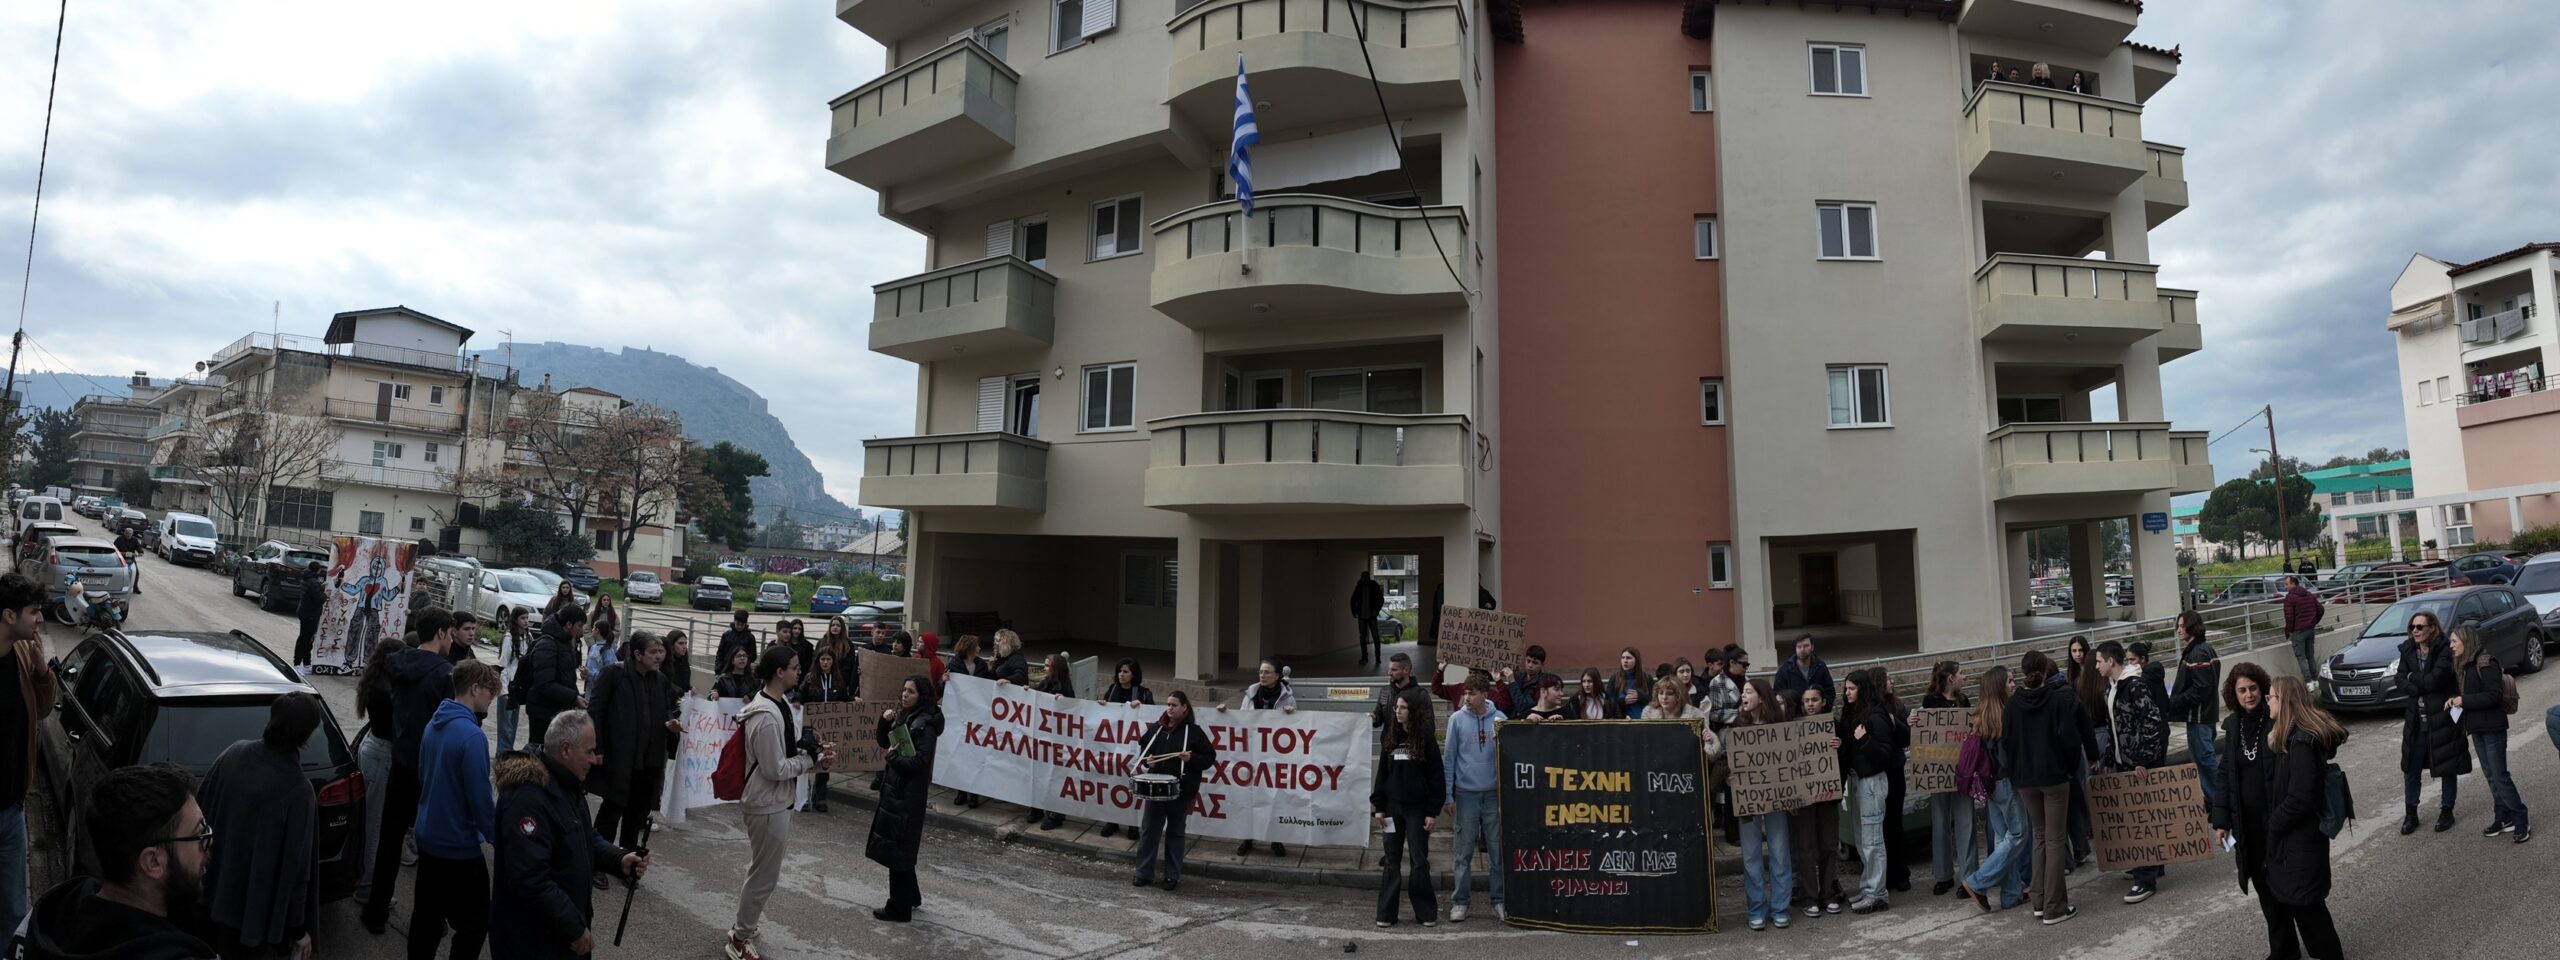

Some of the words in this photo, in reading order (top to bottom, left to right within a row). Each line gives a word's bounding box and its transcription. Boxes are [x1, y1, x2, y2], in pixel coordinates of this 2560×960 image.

[1443, 607, 1463, 618] ΚΑΘΕ
[1468, 610, 1499, 622] ΧΡΟΝΟ
[1501, 615, 1526, 627] ΛΕΝΕ
[1443, 618, 1455, 629] ΘΑ
[1499, 628, 1505, 636] Η
[1441, 630, 1459, 641] ΔΕΙΑ
[1462, 633, 1480, 645] ΕΓΩ
[1482, 637, 1511, 651] ΟΜΩΣ
[1440, 642, 1463, 654] ΚΑΘΕ
[1466, 645, 1495, 659] ΧΡΟΝΟ
[1499, 653, 1522, 664] ΚΑΤΕ
[1475, 658, 1487, 668] ΣΕ
[806, 703, 838, 715] ΕΣΕΙΣ
[846, 701, 866, 713] ΠΟΥ
[810, 716, 852, 730] ΚΟΙΤΑΤΕ
[860, 715, 875, 725] ΤΟΝ
[991, 697, 1031, 727] ΟΧΙ
[1038, 708, 1084, 739] ΣΤΗ
[1258, 727, 1317, 755] ΤΟΥ
[1916, 710, 1959, 727] ΕΜΕΙΣ
[1733, 728, 1777, 746] ΜΟΡΙΑ
[1920, 730, 1937, 744] ΓΙΑ
[964, 722, 1146, 777] ΚΑΛΛΙΤΕΧΝΙΚ
[1733, 750, 1782, 768] ΕΧΟΥΝ
[1786, 749, 1797, 763] ΟΙ
[1514, 763, 1534, 789] Η
[1545, 767, 1631, 792] ΤΕΧΝΗ
[1648, 772, 1695, 793] ΜΑΣ
[1733, 770, 1771, 785] ΤΕΣ
[1818, 757, 1833, 774] ΟΙ
[2090, 777, 2121, 792] ΚΑΤΩ
[2125, 774, 2139, 787] ΤΑ
[2145, 768, 2177, 786] ΧΕΡΙΑ
[2181, 768, 2197, 781] ΑΠΟ
[1736, 786, 1797, 803] ΜΟΥΣΙΚΟΙ
[2092, 795, 2119, 808] ΤΟΝ
[1545, 803, 1632, 826] ΕΝΩΝΕΙ
[1739, 803, 1766, 815] ΔΕΝ
[2097, 812, 2124, 825] ΤΗΝ
[2128, 807, 2177, 825] ΤΕΧΝΗ
[2177, 804, 2207, 819] ΤΗΝ
[1279, 816, 1315, 827] Σύλλογος
[1316, 818, 1345, 827] Γονέων
[2101, 823, 2177, 841] ΑΓΓΙΖΑΤΕ
[2185, 820, 2204, 837] ΘΑ
[1514, 849, 1592, 872] ΚΑΝΕΙΣ
[1599, 850, 1635, 871] ΔΕΝ
[1642, 850, 1678, 870] ΜΑΣ
[2104, 844, 2168, 863] ΚΑΝΟΥΜΕ
